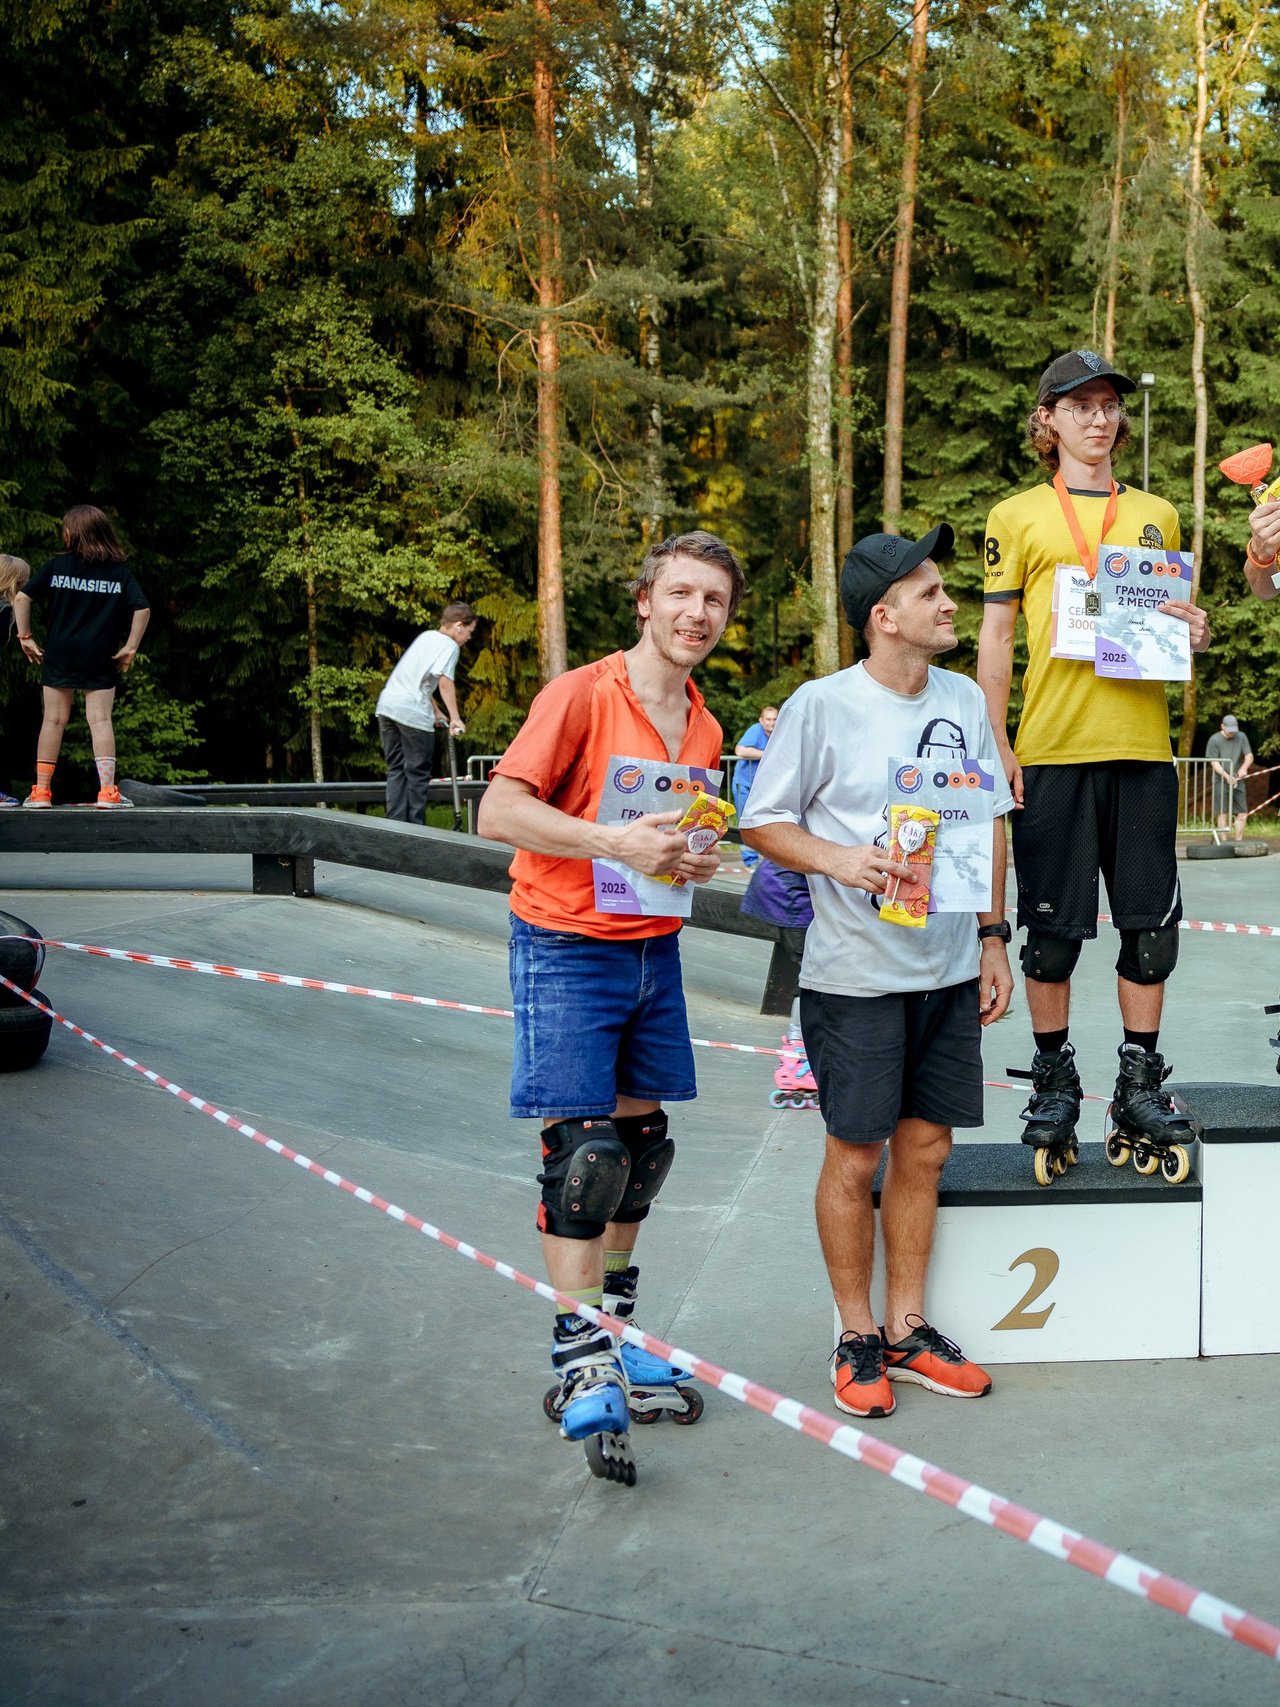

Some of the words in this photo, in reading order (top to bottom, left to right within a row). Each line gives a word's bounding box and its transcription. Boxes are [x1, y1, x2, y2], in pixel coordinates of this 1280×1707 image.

[50, 574, 122, 594] AFANASIEVA
[1115, 585, 1170, 599] ГРАМОТА
[1118, 597, 1125, 606] 2
[1068, 618, 1095, 631] 3000
[1102, 652, 1127, 663] 2025
[601, 882, 627, 894] 2025
[991, 1247, 1060, 1331] 2
